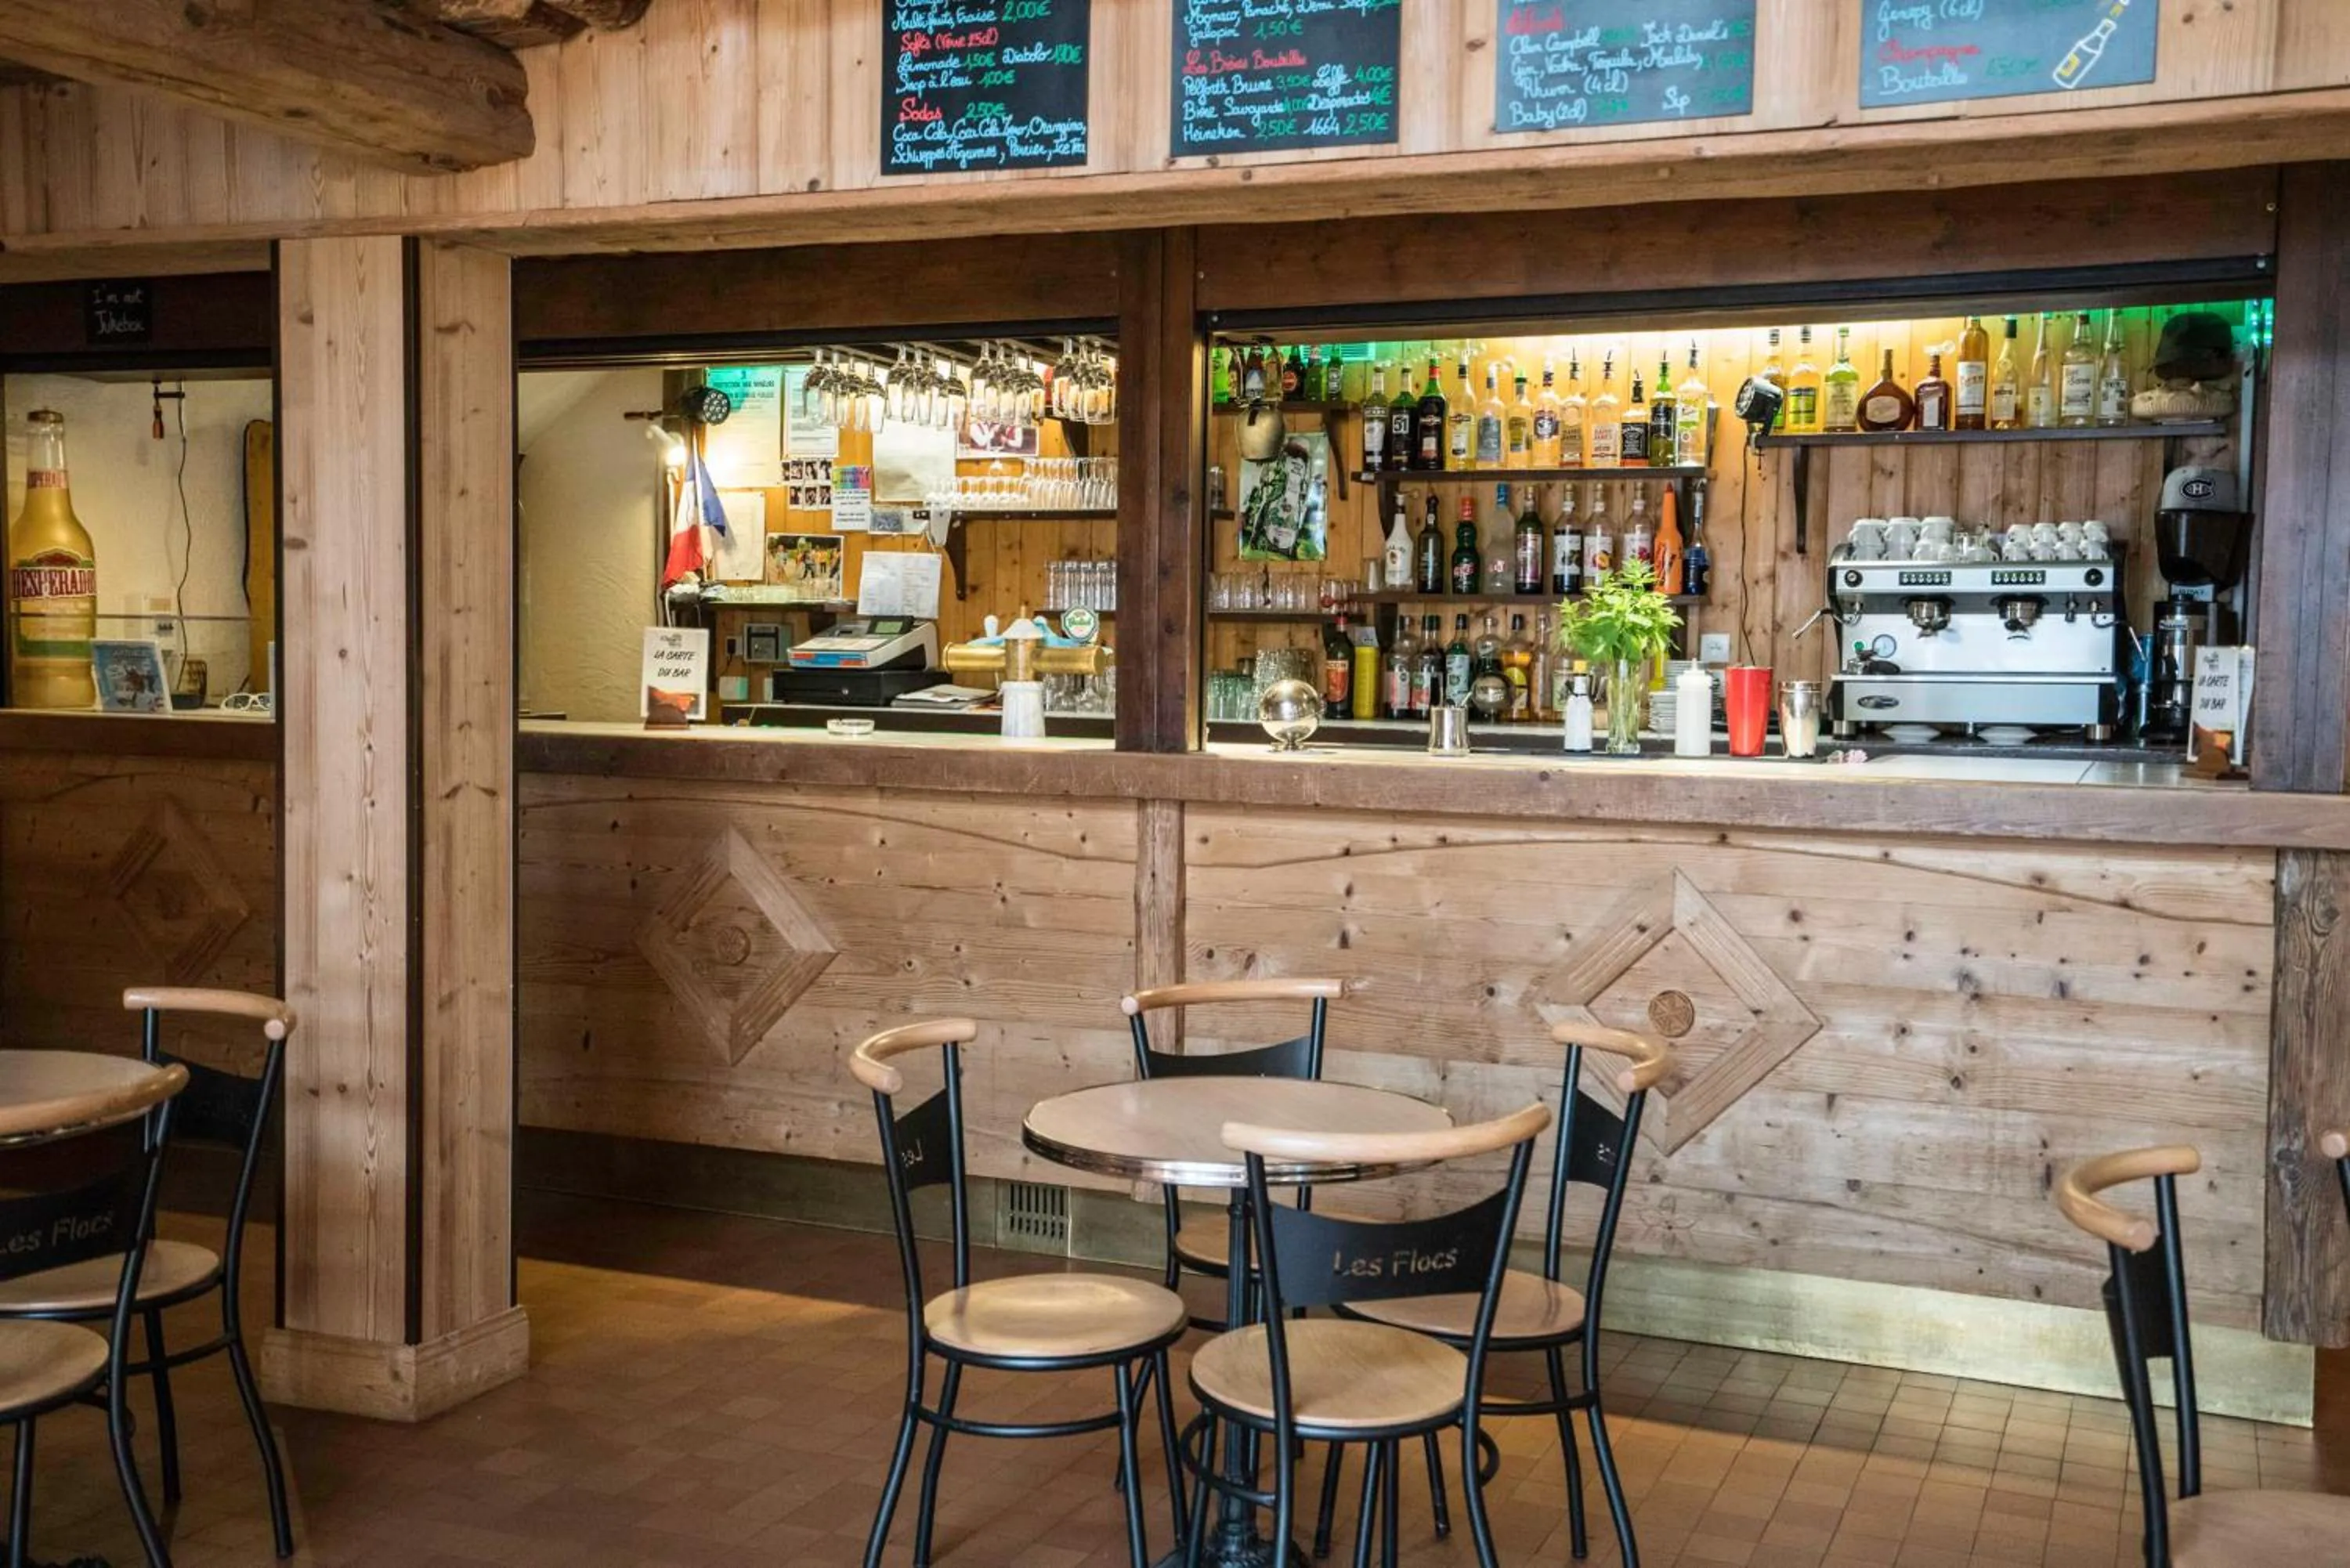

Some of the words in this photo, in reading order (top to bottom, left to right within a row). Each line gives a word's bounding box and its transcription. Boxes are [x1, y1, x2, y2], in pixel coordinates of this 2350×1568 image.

[1002, 42, 1053, 63] Diabolo
[899, 97, 943, 121] Sodas
[893, 122, 924, 142] Coca
[1303, 117, 1340, 136] 1664
[1393, 417, 1408, 432] 51
[653, 650, 666, 661] LA
[666, 651, 696, 661] CARTE
[657, 668, 670, 677] DU
[671, 667, 692, 678] BAR
[2207, 674, 2230, 688] CARTE
[2210, 698, 2228, 711] BAR
[1332, 1249, 1383, 1278] Les
[1391, 1246, 1459, 1278] Flocs
